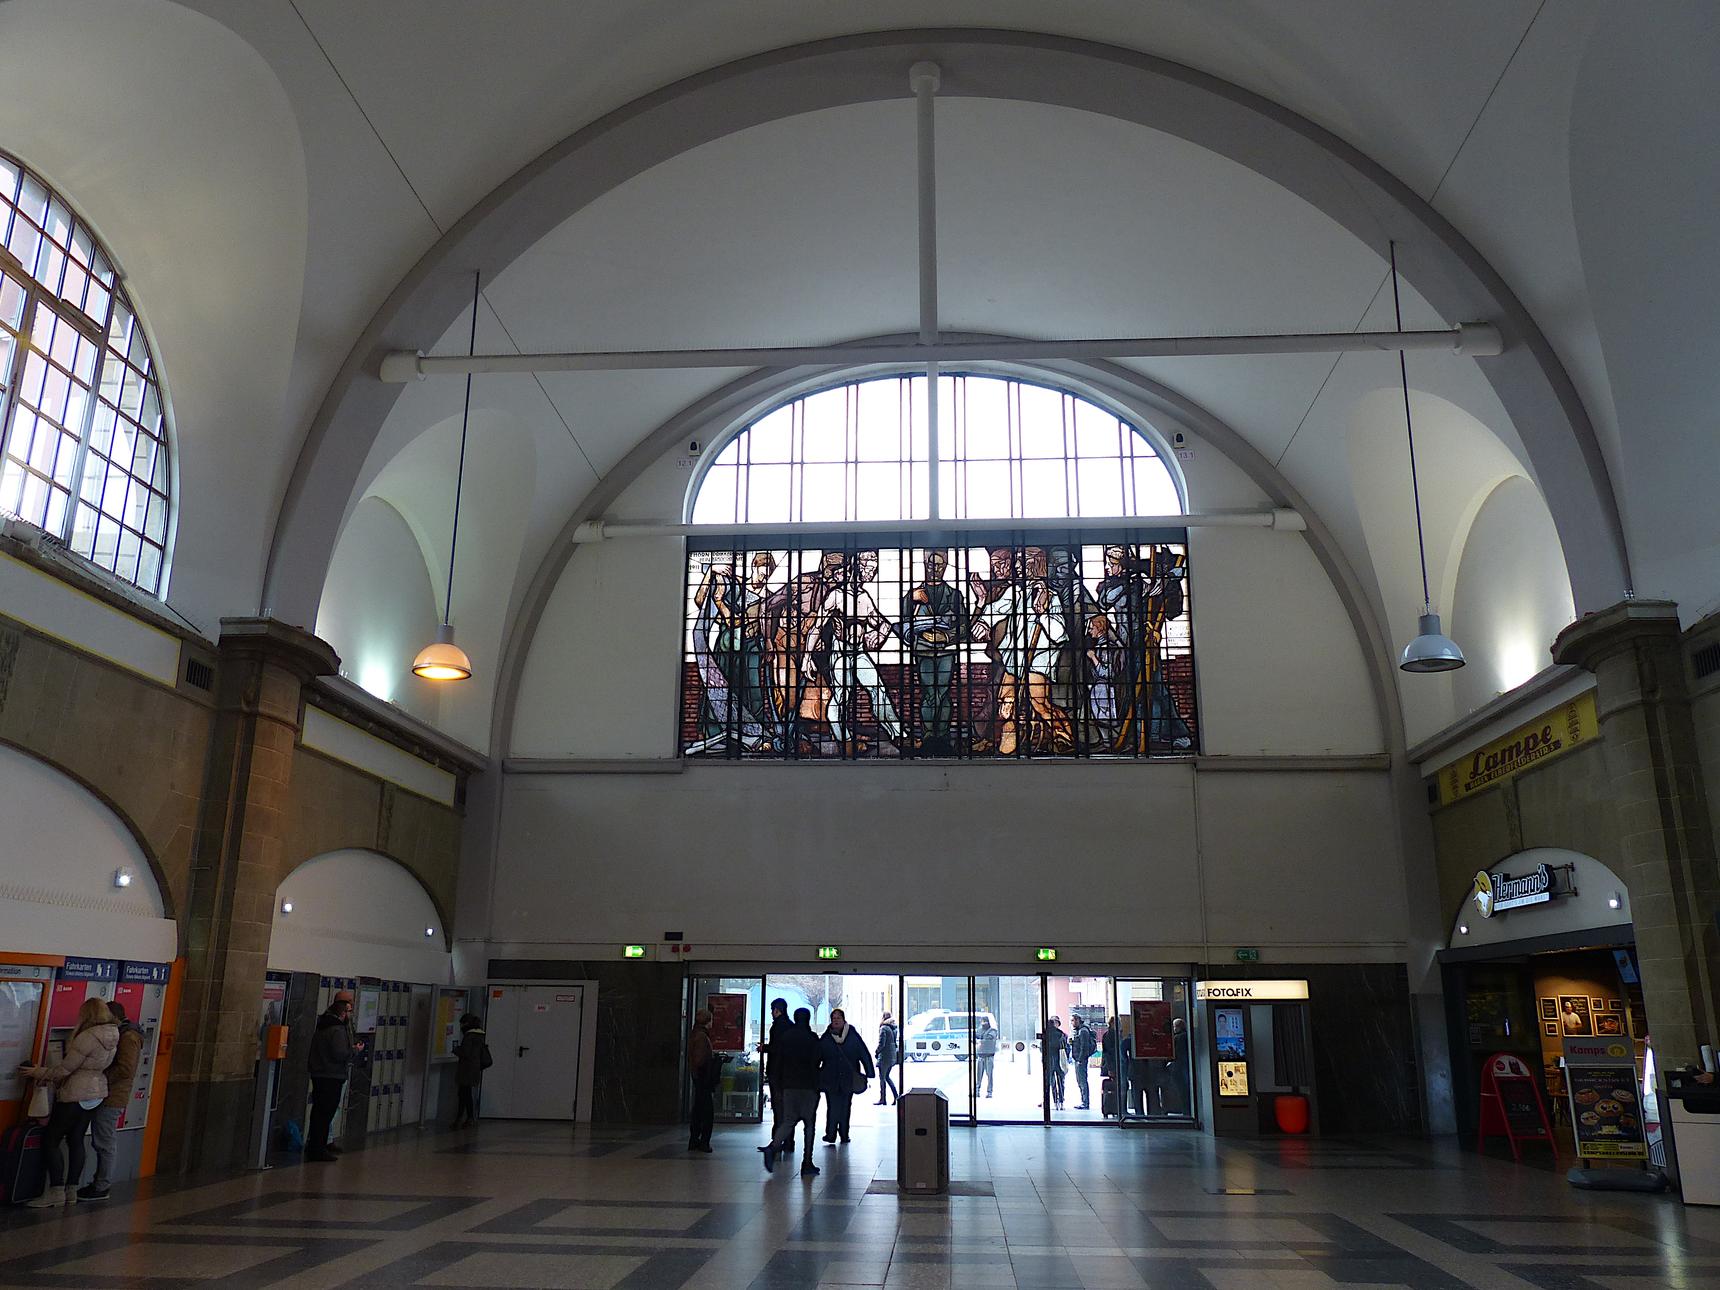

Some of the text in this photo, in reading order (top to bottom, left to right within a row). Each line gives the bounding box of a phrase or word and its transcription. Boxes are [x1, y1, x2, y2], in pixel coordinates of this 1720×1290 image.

[1469, 725, 1553, 779] Lampe
[1492, 863, 1549, 903] Hermann's
[66, 962, 92, 971] Fahrkarten
[1570, 1046, 1605, 1056] Kamps
